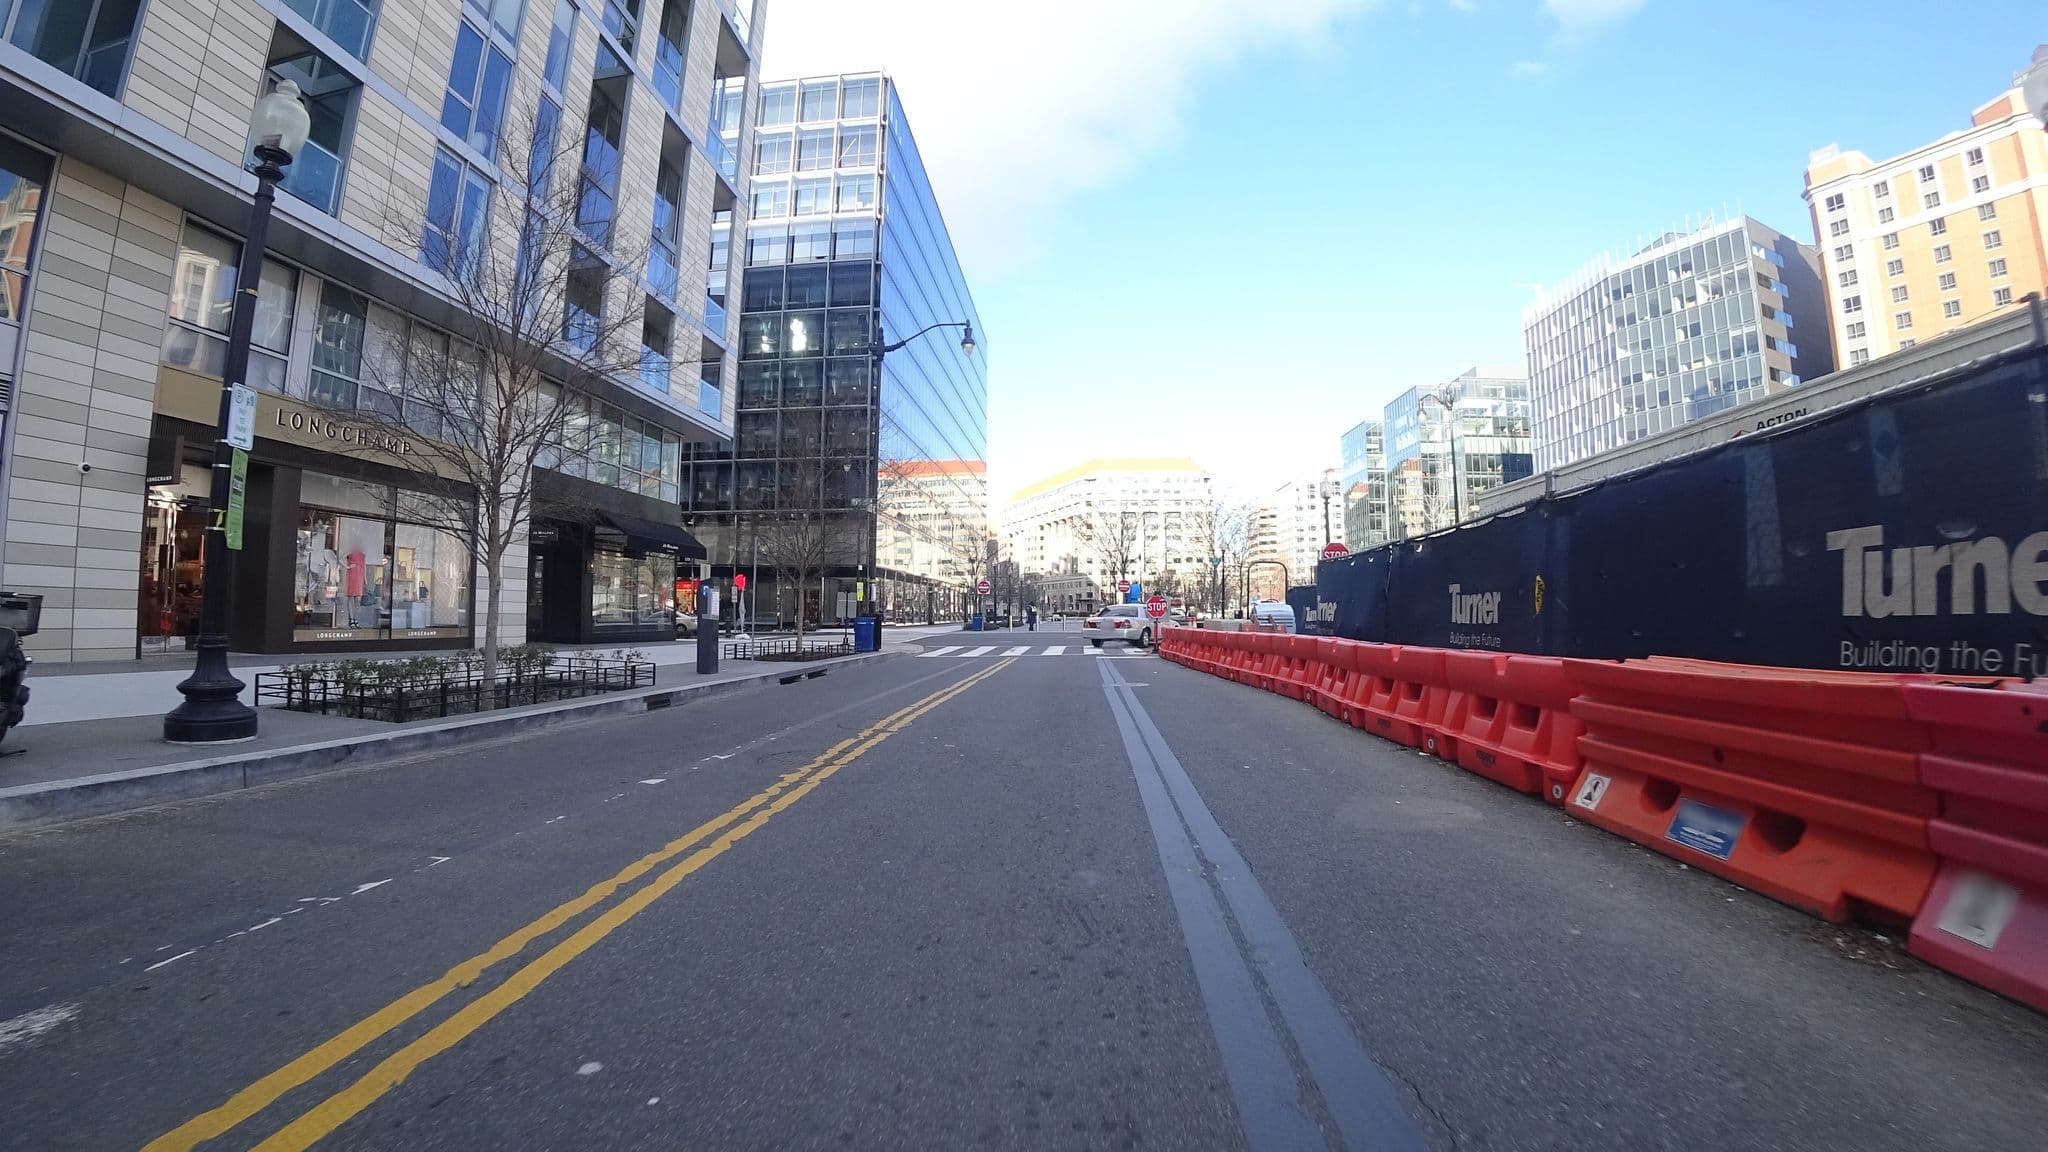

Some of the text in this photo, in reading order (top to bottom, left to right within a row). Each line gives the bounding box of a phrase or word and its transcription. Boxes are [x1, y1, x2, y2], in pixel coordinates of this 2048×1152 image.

[275, 407, 412, 455] LONGCHAMP
[1756, 407, 1808, 430] ACTON
[1148, 602, 1167, 611] STOP
[1449, 584, 1501, 624] Turner
[1840, 640, 1940, 674] Building
[1950, 640, 2003, 672] the
